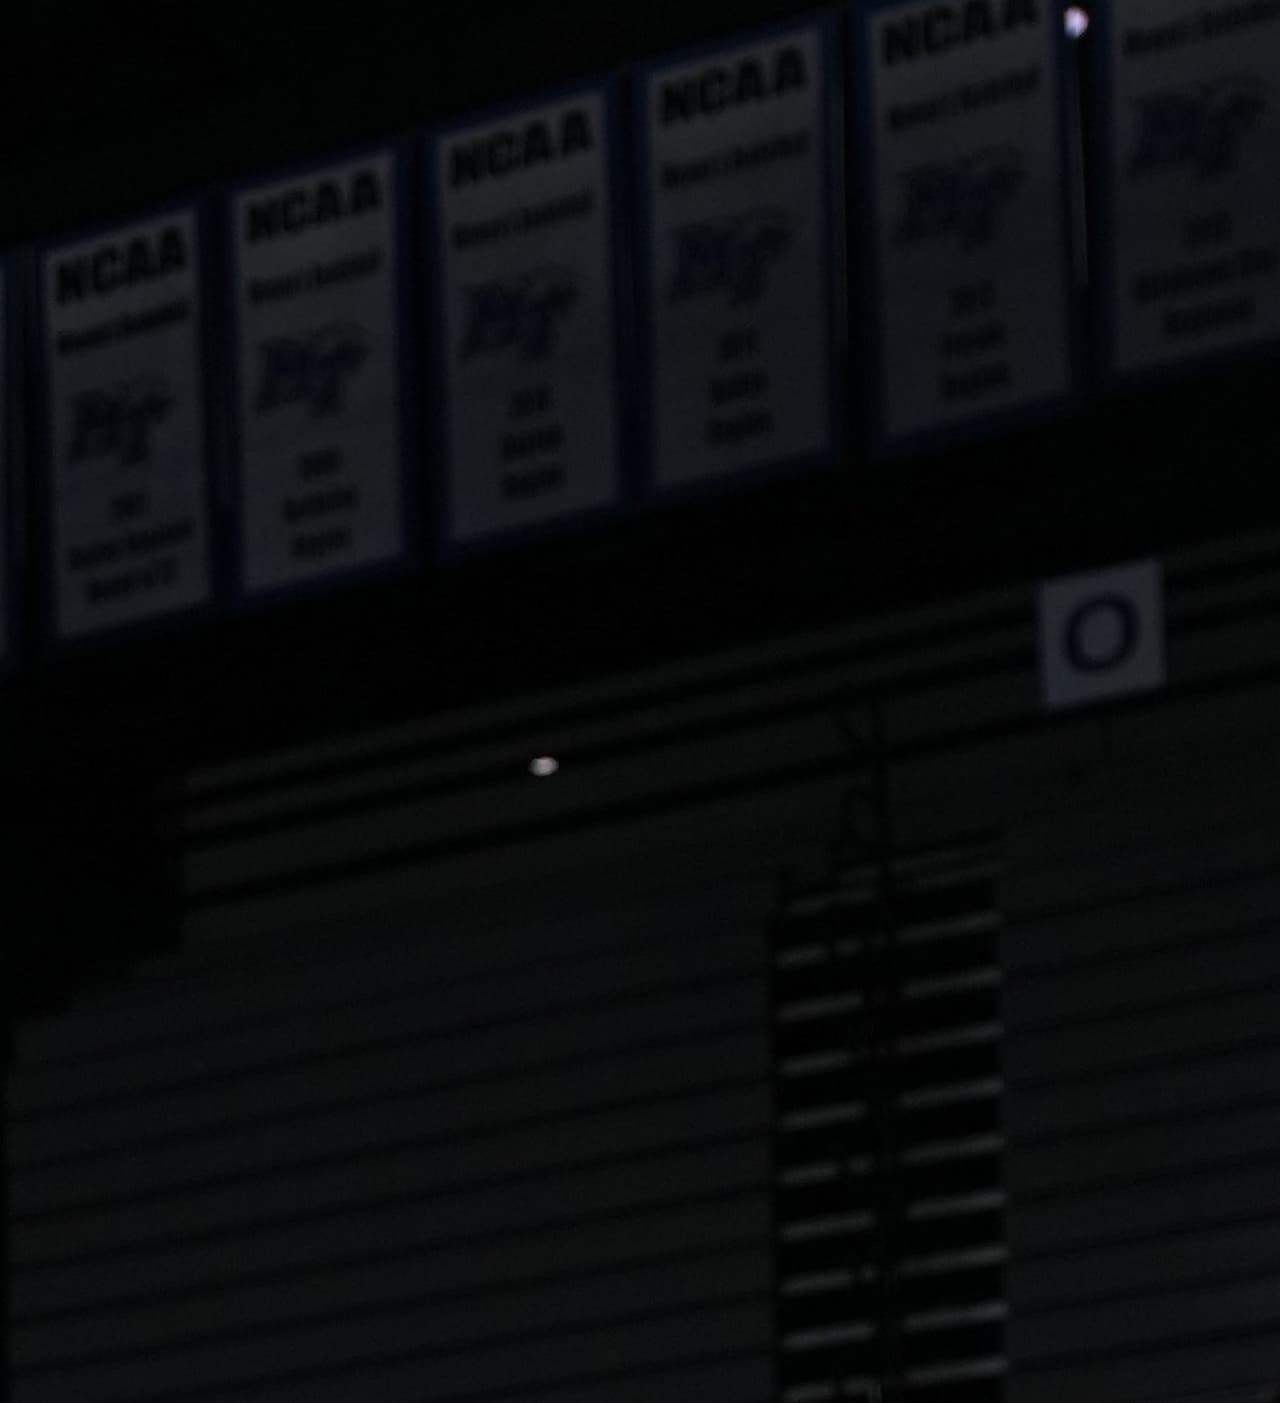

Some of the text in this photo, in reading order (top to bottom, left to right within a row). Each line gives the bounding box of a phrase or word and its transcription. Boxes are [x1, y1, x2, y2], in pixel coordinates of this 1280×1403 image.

[660, 46, 808, 125] NCAA
[447, 107, 593, 188] NCAA
[246, 168, 385, 244] NCAA
[54, 225, 188, 304] NCAA
